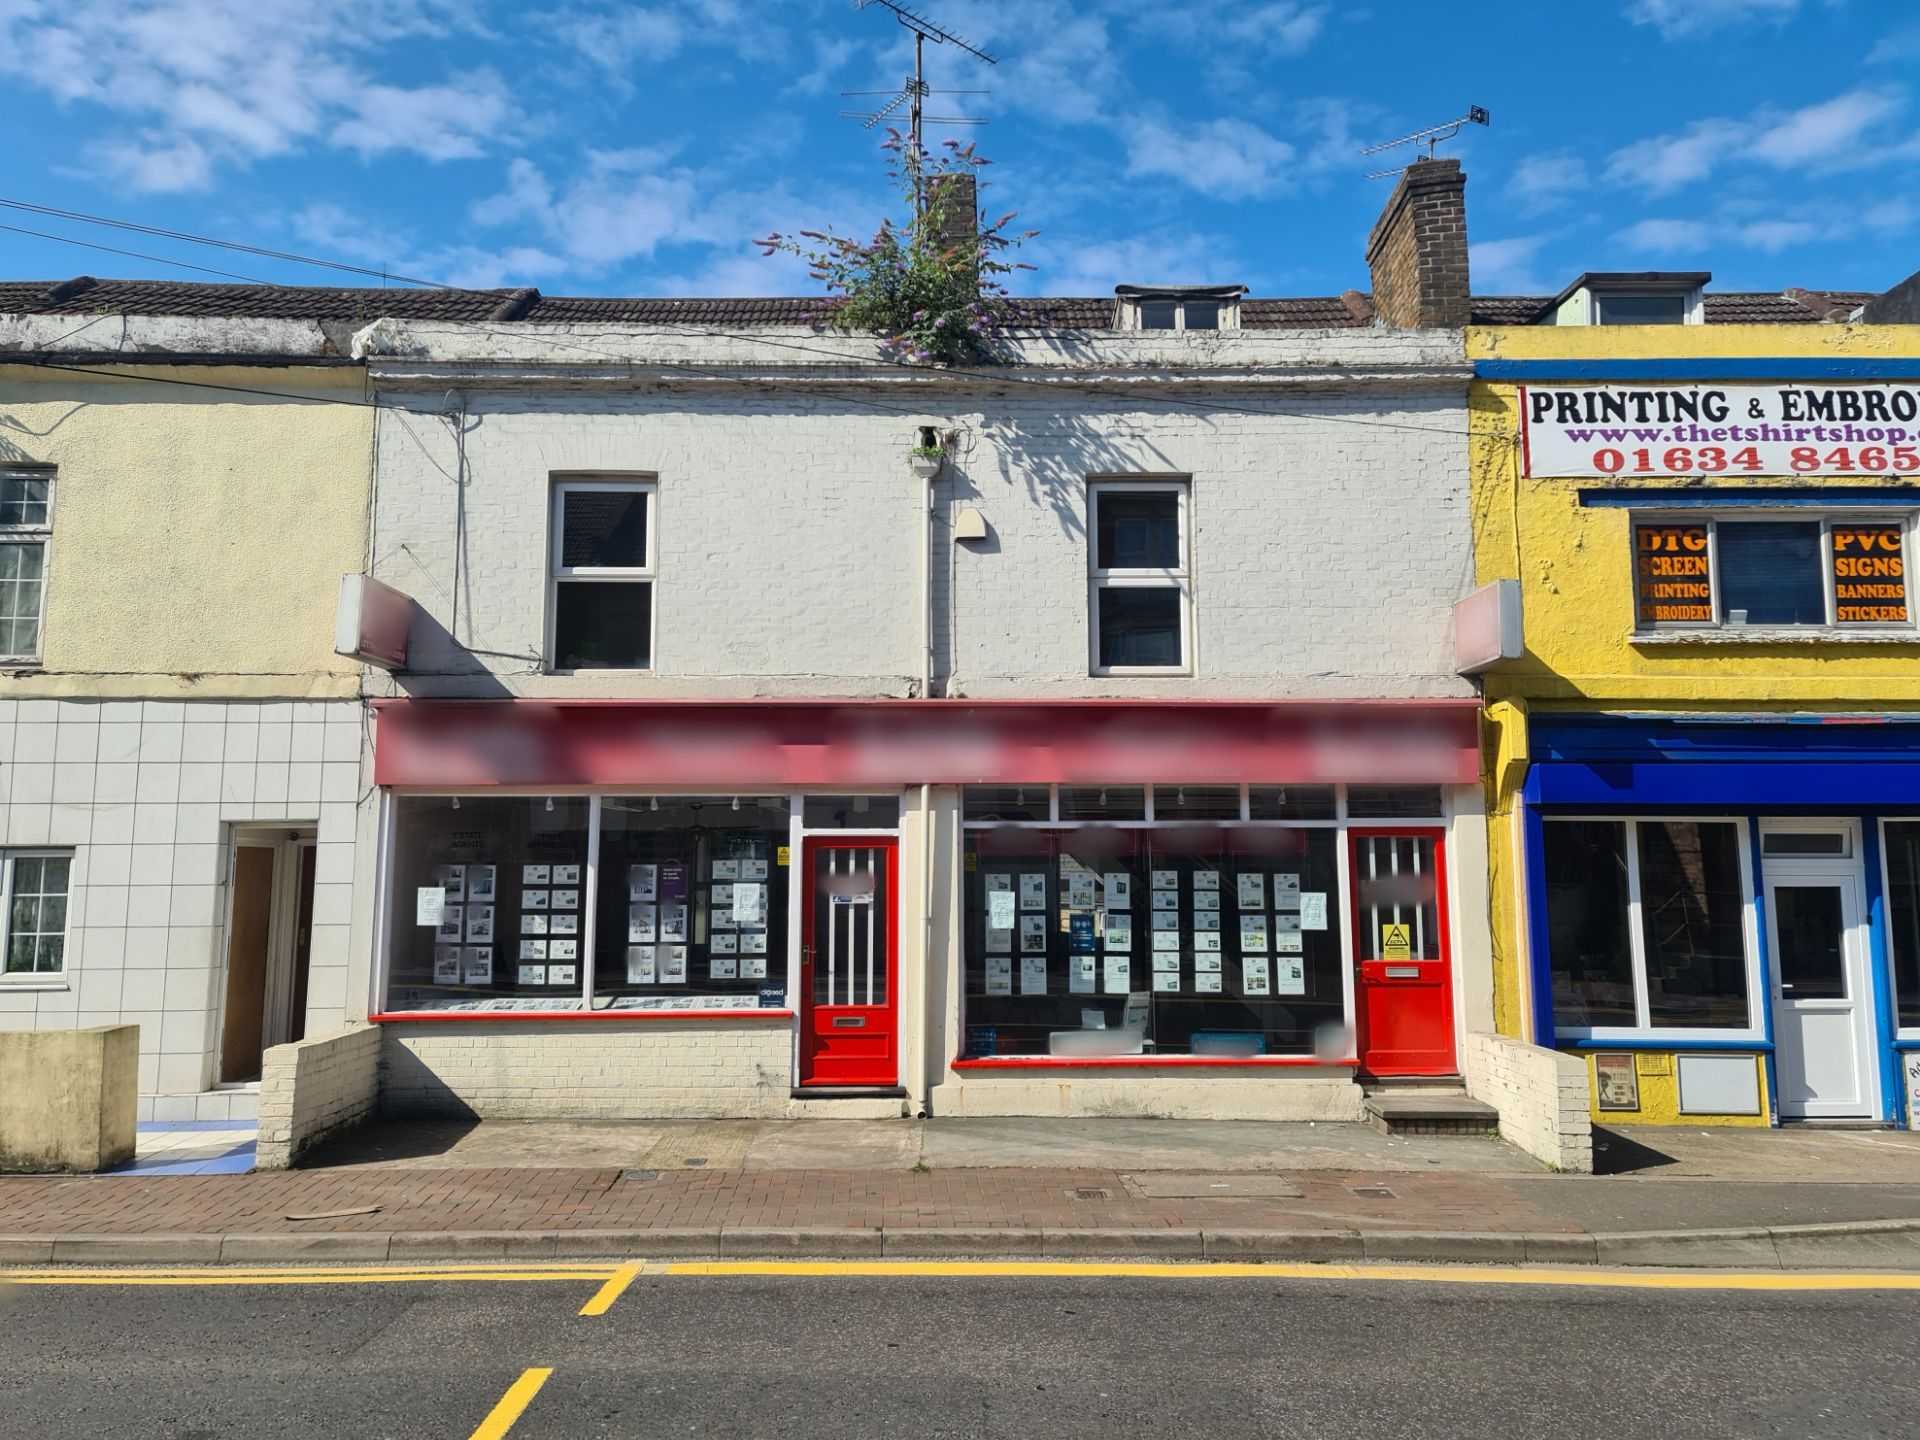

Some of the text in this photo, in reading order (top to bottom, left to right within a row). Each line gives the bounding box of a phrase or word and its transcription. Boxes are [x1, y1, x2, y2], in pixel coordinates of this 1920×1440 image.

[1530, 390, 1920, 423] PRINTING & EMBRO
[1564, 424, 1920, 446] www.thetshirtshop.
[1593, 446, 1920, 473] 01634 8465
[1637, 528, 1708, 551] DTG
[1833, 529, 1902, 551] PVC
[1639, 556, 1708, 576] SCREEN
[1835, 557, 1903, 577] SIGNS
[1640, 583, 1709, 599] PRINTING
[1836, 584, 1905, 599] BANNERS
[1641, 605, 1712, 621] EMBROIDERY
[1837, 606, 1907, 621] STICKERS
